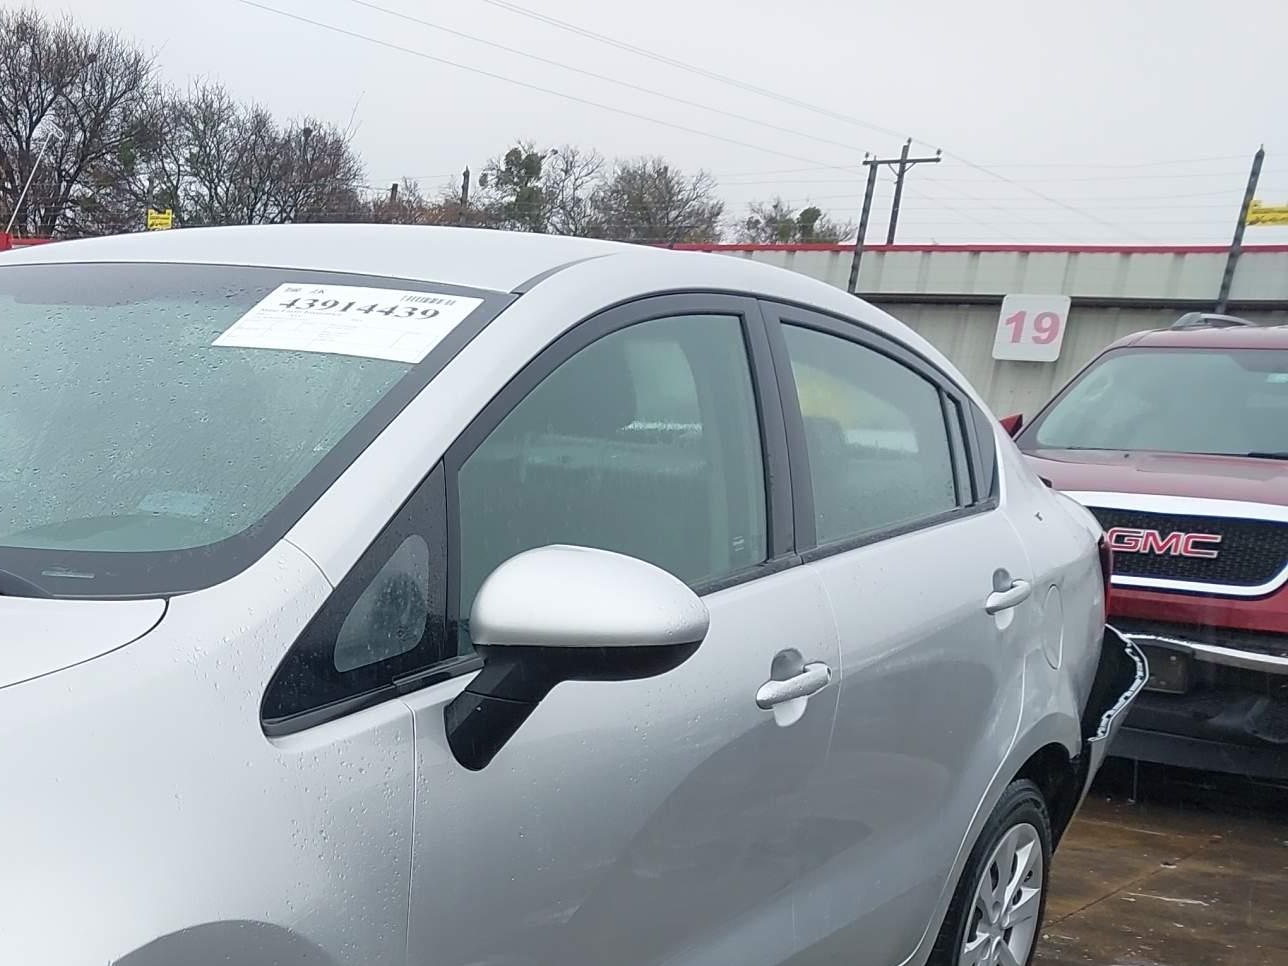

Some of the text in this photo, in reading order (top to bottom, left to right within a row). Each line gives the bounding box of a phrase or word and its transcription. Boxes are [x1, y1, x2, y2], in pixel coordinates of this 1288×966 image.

[279, 297, 440, 320] 43914439
[1005, 310, 1061, 345] 19
[1107, 527, 1223, 558] GMC
